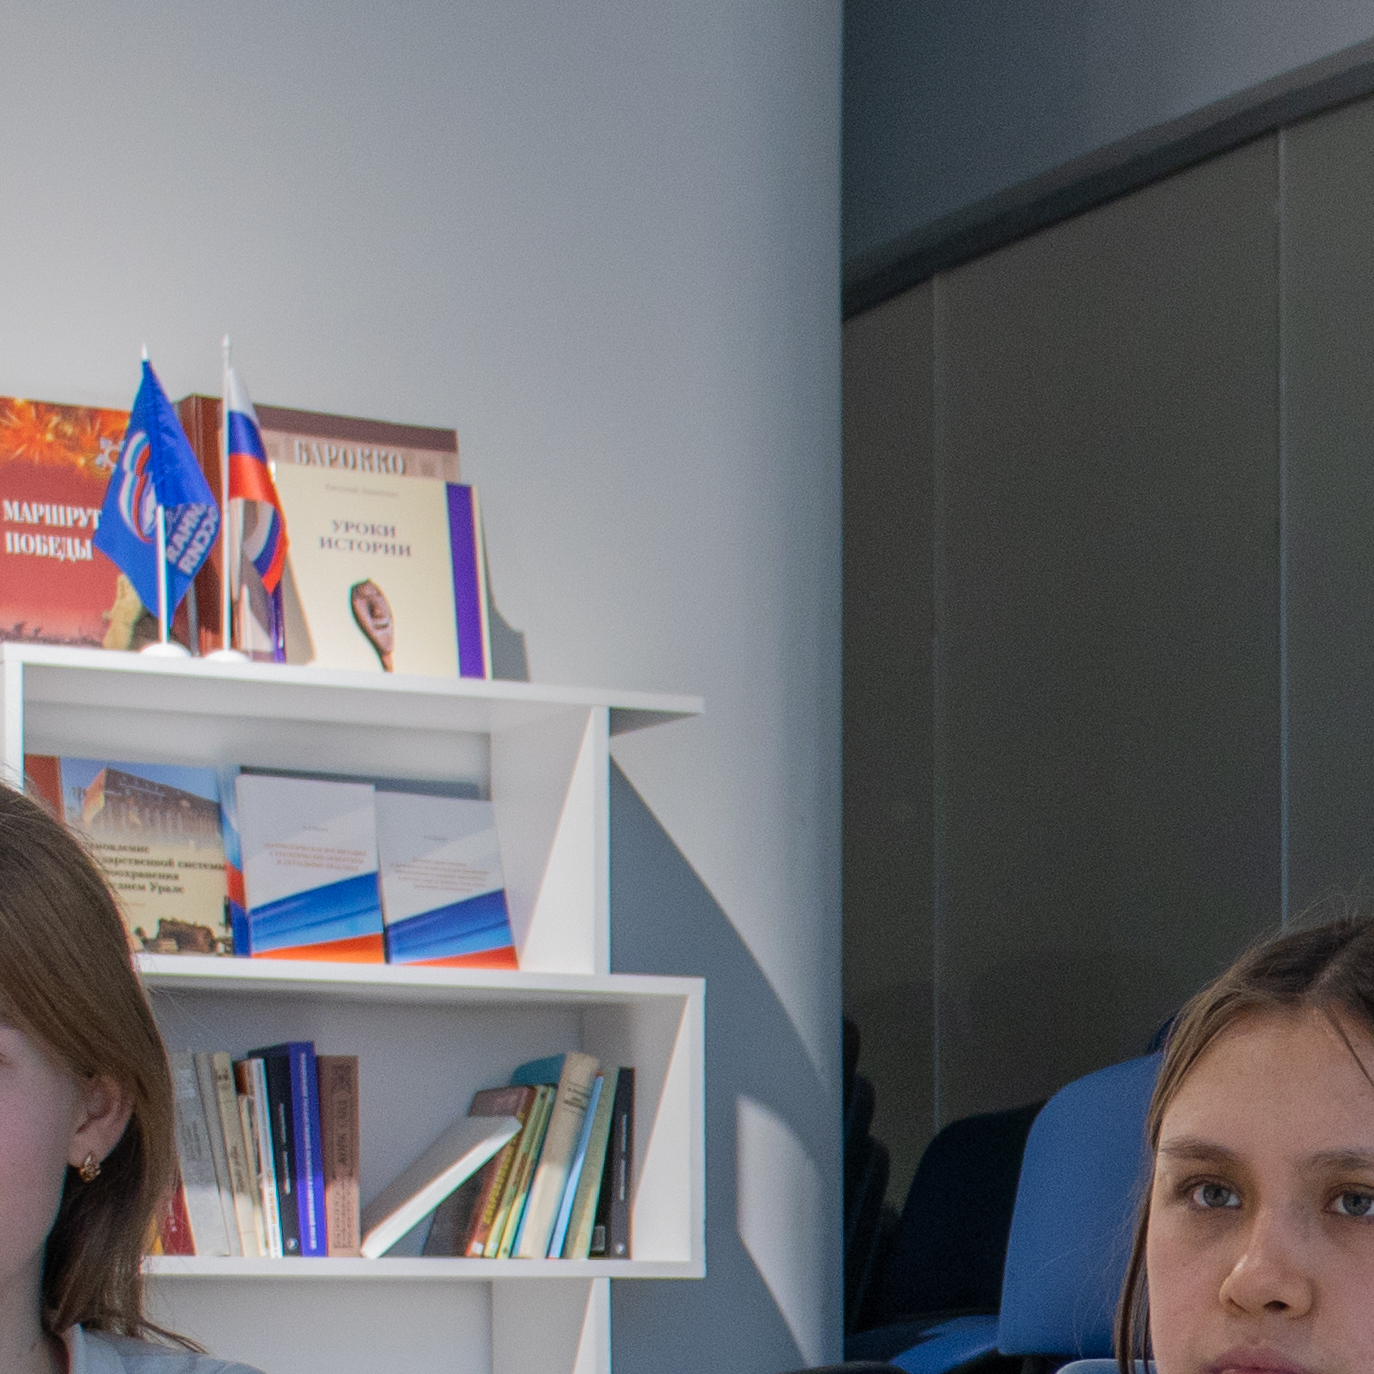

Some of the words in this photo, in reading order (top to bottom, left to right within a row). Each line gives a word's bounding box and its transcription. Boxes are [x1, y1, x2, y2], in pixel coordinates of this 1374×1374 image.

[294, 439, 406, 476] БАРОККО
[2, 498, 102, 530] МАРШРУТ
[331, 519, 397, 539] УРОКИ
[5, 531, 93, 562] ПОБЕДЫ
[319, 536, 412, 557] ИСТОРИИ
